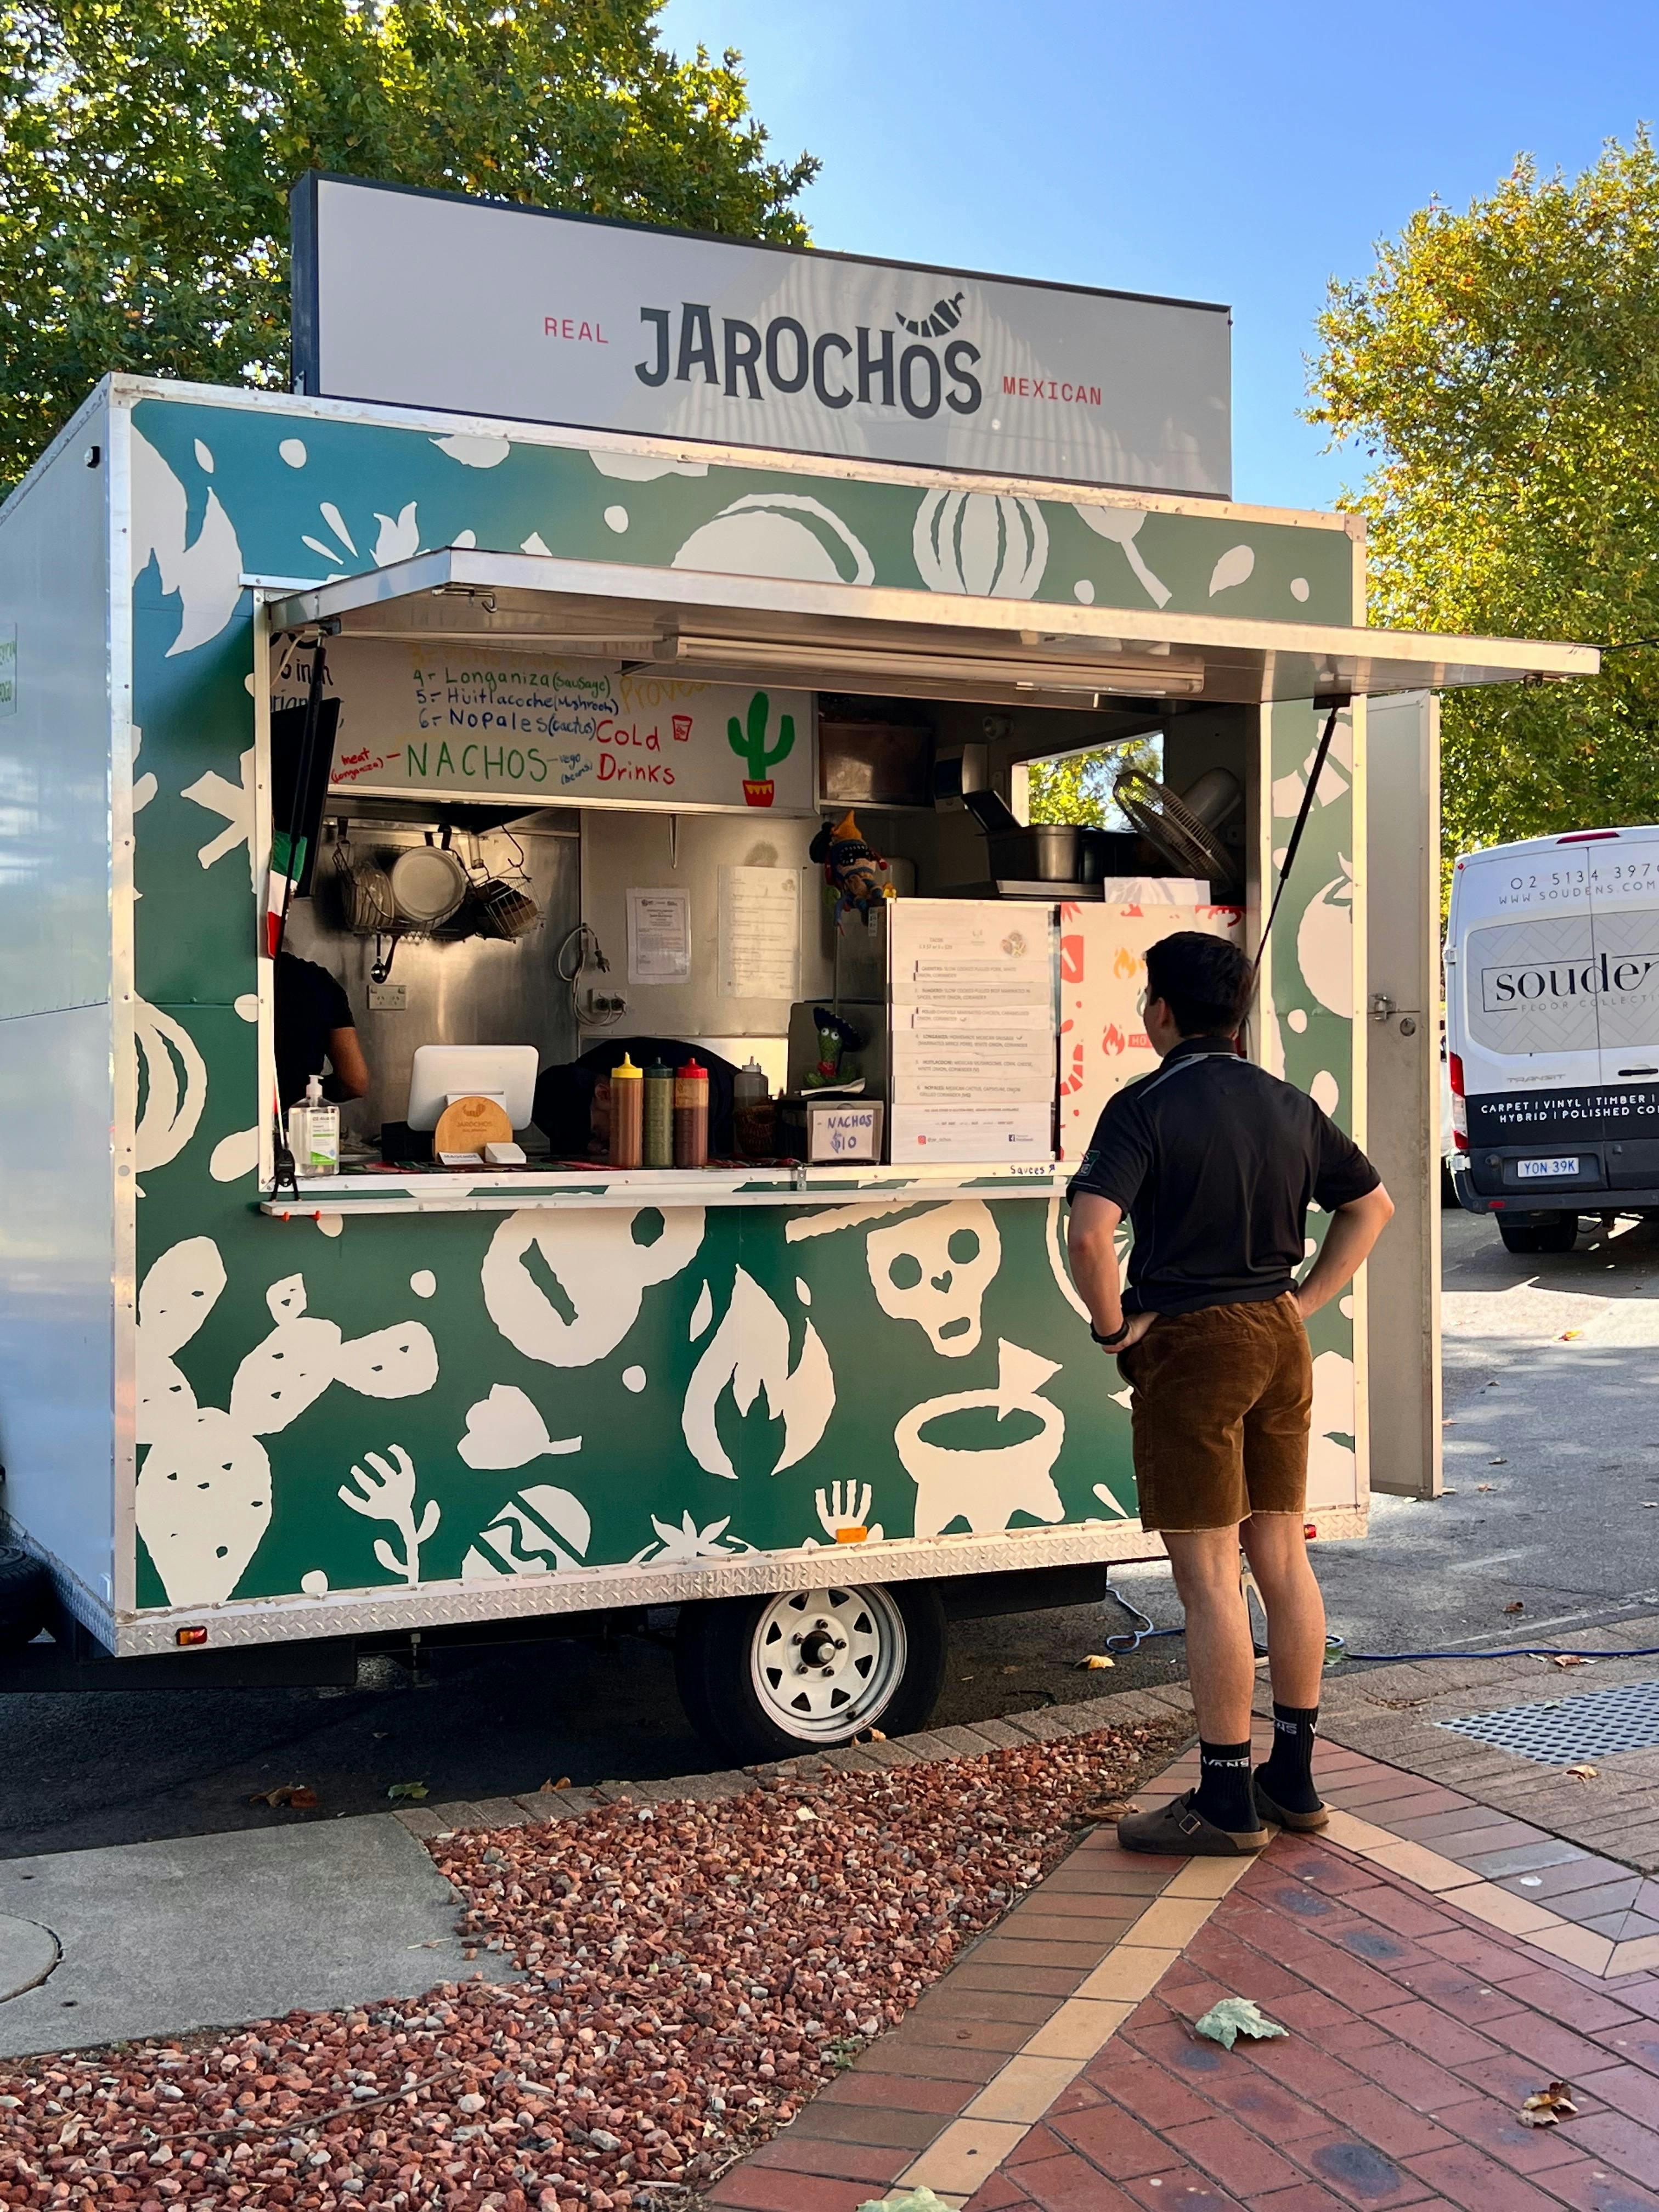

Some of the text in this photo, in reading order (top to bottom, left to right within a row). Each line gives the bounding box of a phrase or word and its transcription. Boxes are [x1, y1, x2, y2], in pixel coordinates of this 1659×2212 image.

[543, 302, 1102, 420] REAL JAROCHOS MEXICAN
[296, 658, 334, 686] inh
[408, 741, 548, 782] NACHOS
[1510, 863, 1659, 890] 02 5134 397
[1521, 994, 1659, 1012] FLOOR COLLECTI
[1132, 1035, 1150, 1046] HO
[1481, 1094, 1645, 1114] CARPET VINYL TIMBER
[1499, 1104, 1659, 1123] HYBRID POLISHED CO
[828, 1114, 872, 1129] NACHOS
[830, 1129, 857, 1154] $10
[1010, 1165, 1045, 1175] Sauces
[1524, 1159, 1576, 1175] YON 39K
